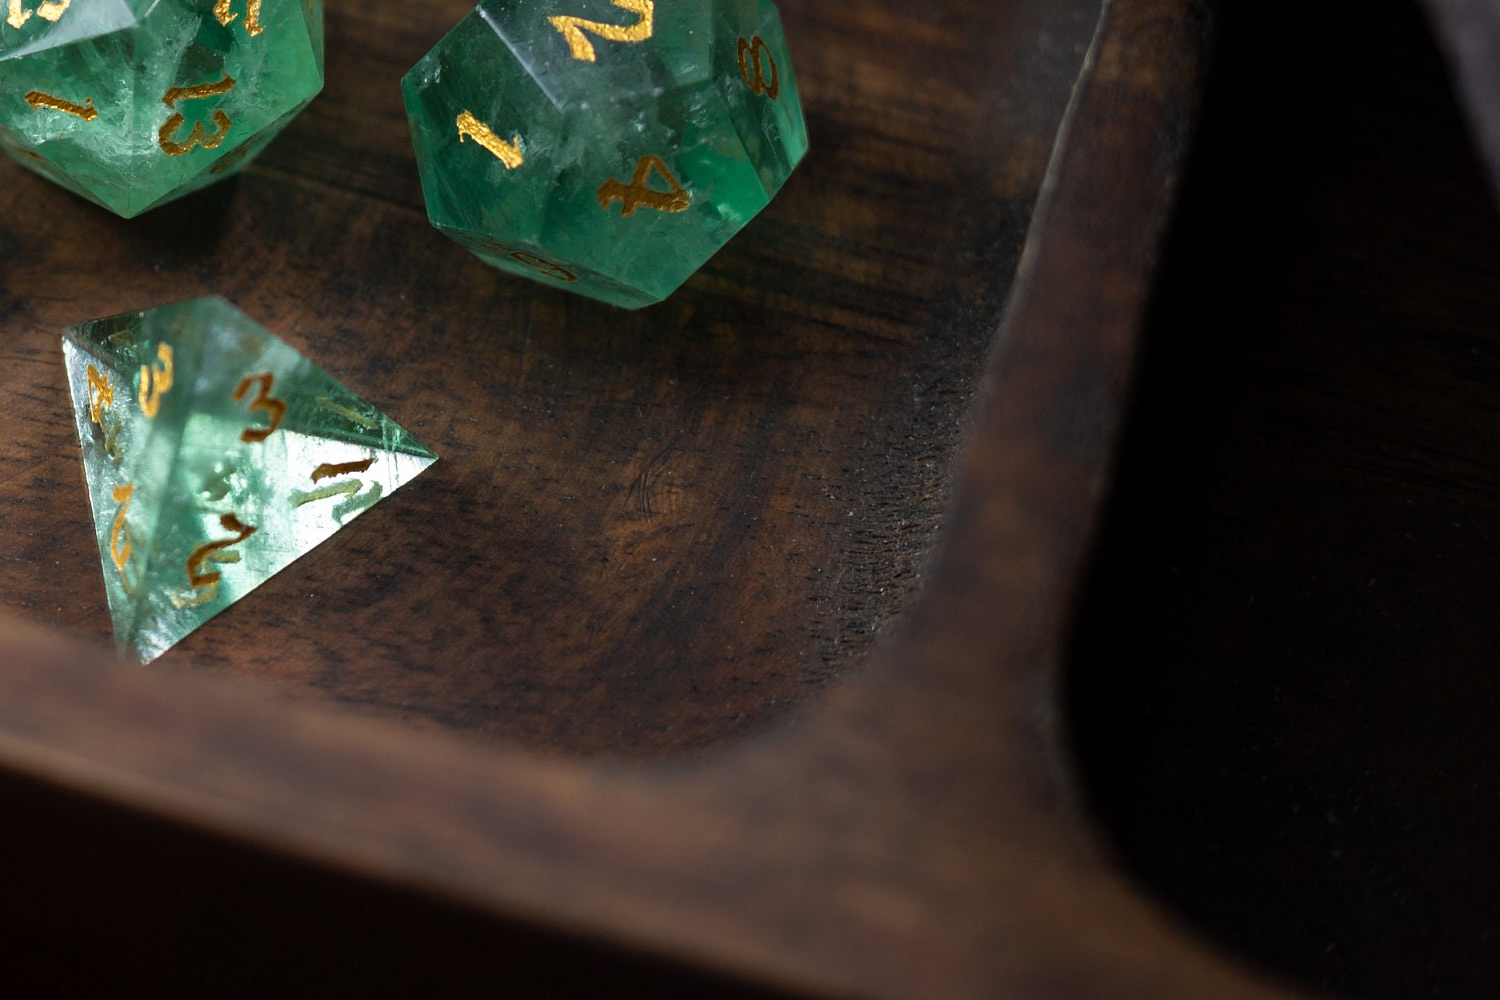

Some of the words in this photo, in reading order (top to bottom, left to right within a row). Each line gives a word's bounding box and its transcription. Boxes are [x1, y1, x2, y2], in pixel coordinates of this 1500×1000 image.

[24, 90, 99, 122] 1
[158, 72, 236, 156] 13
[456, 110, 524, 169] 1
[596, 154, 690, 217] 4
[233, 372, 287, 443] 3
[187, 512, 258, 589] 2
